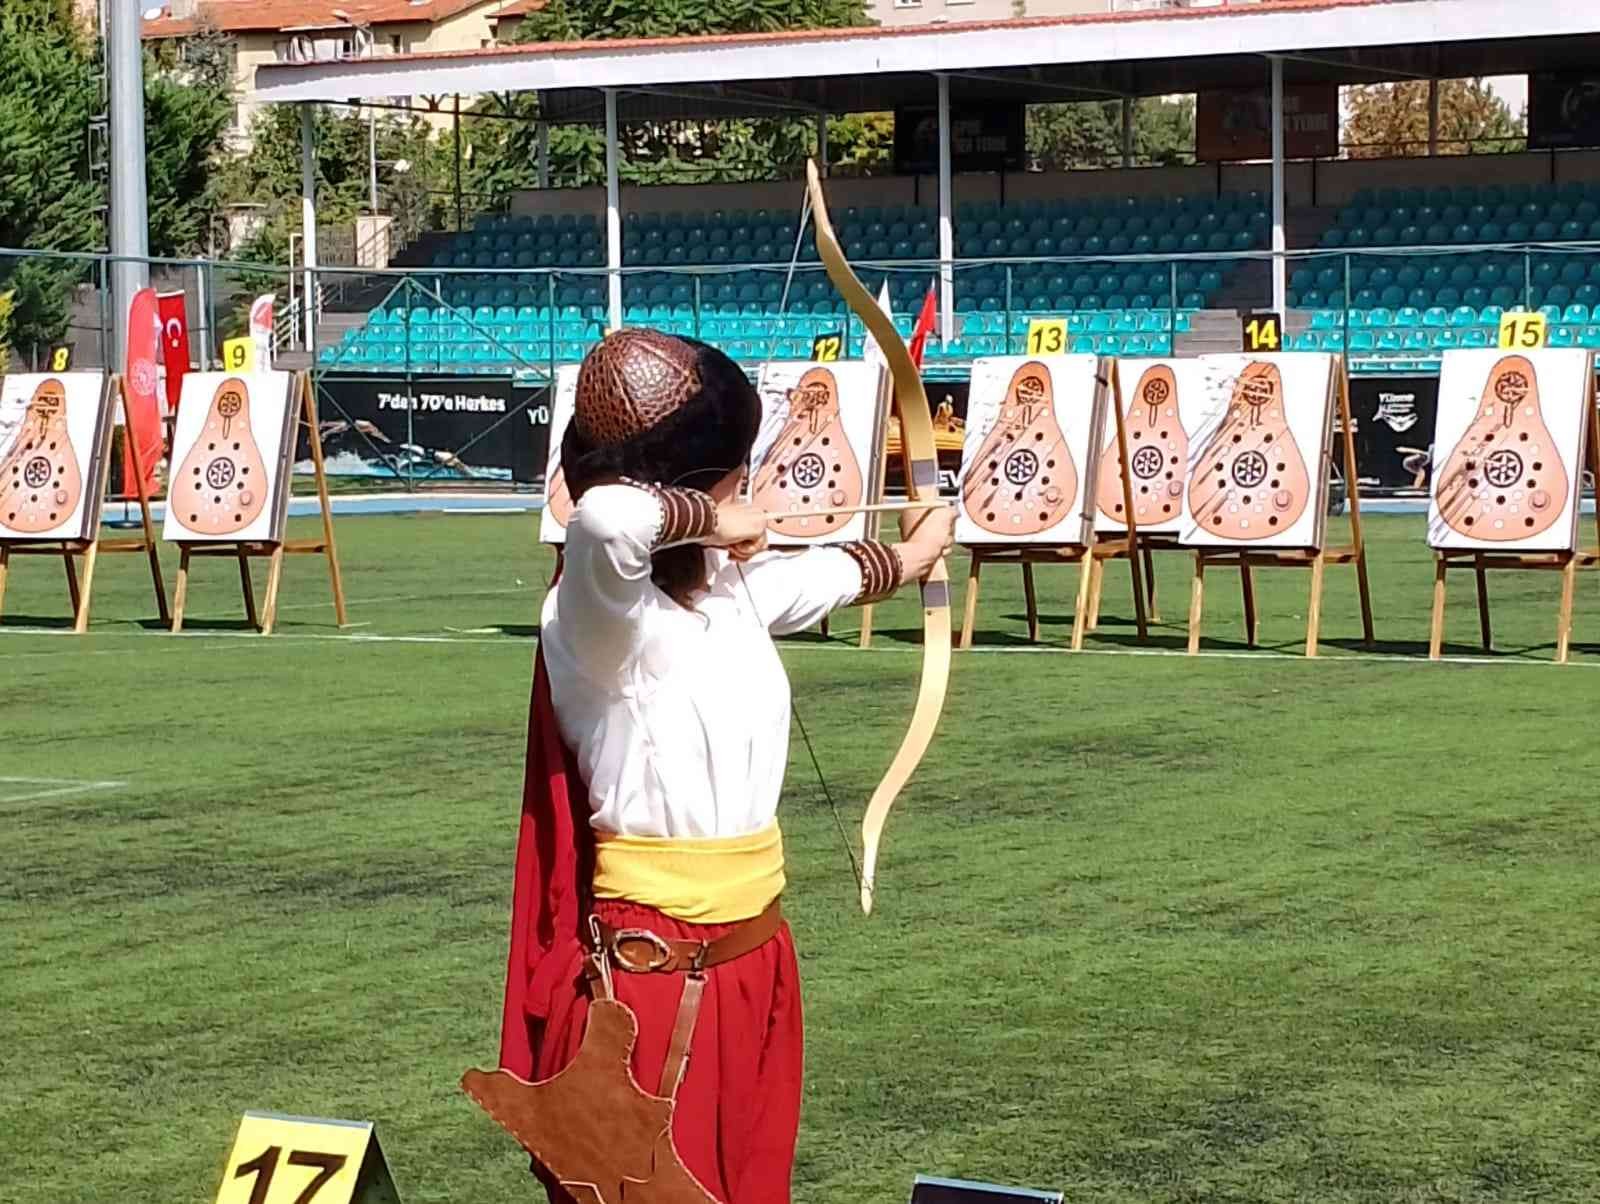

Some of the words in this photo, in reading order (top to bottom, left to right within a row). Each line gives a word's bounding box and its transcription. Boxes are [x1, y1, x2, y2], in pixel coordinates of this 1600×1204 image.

[1031, 326, 1063, 353] 13
[1245, 319, 1279, 350] 14
[1503, 319, 1541, 348] 15
[53, 347, 69, 372] 8
[233, 345, 246, 368] 9
[815, 336, 840, 361] 12
[234, 1145, 348, 1204] 17
